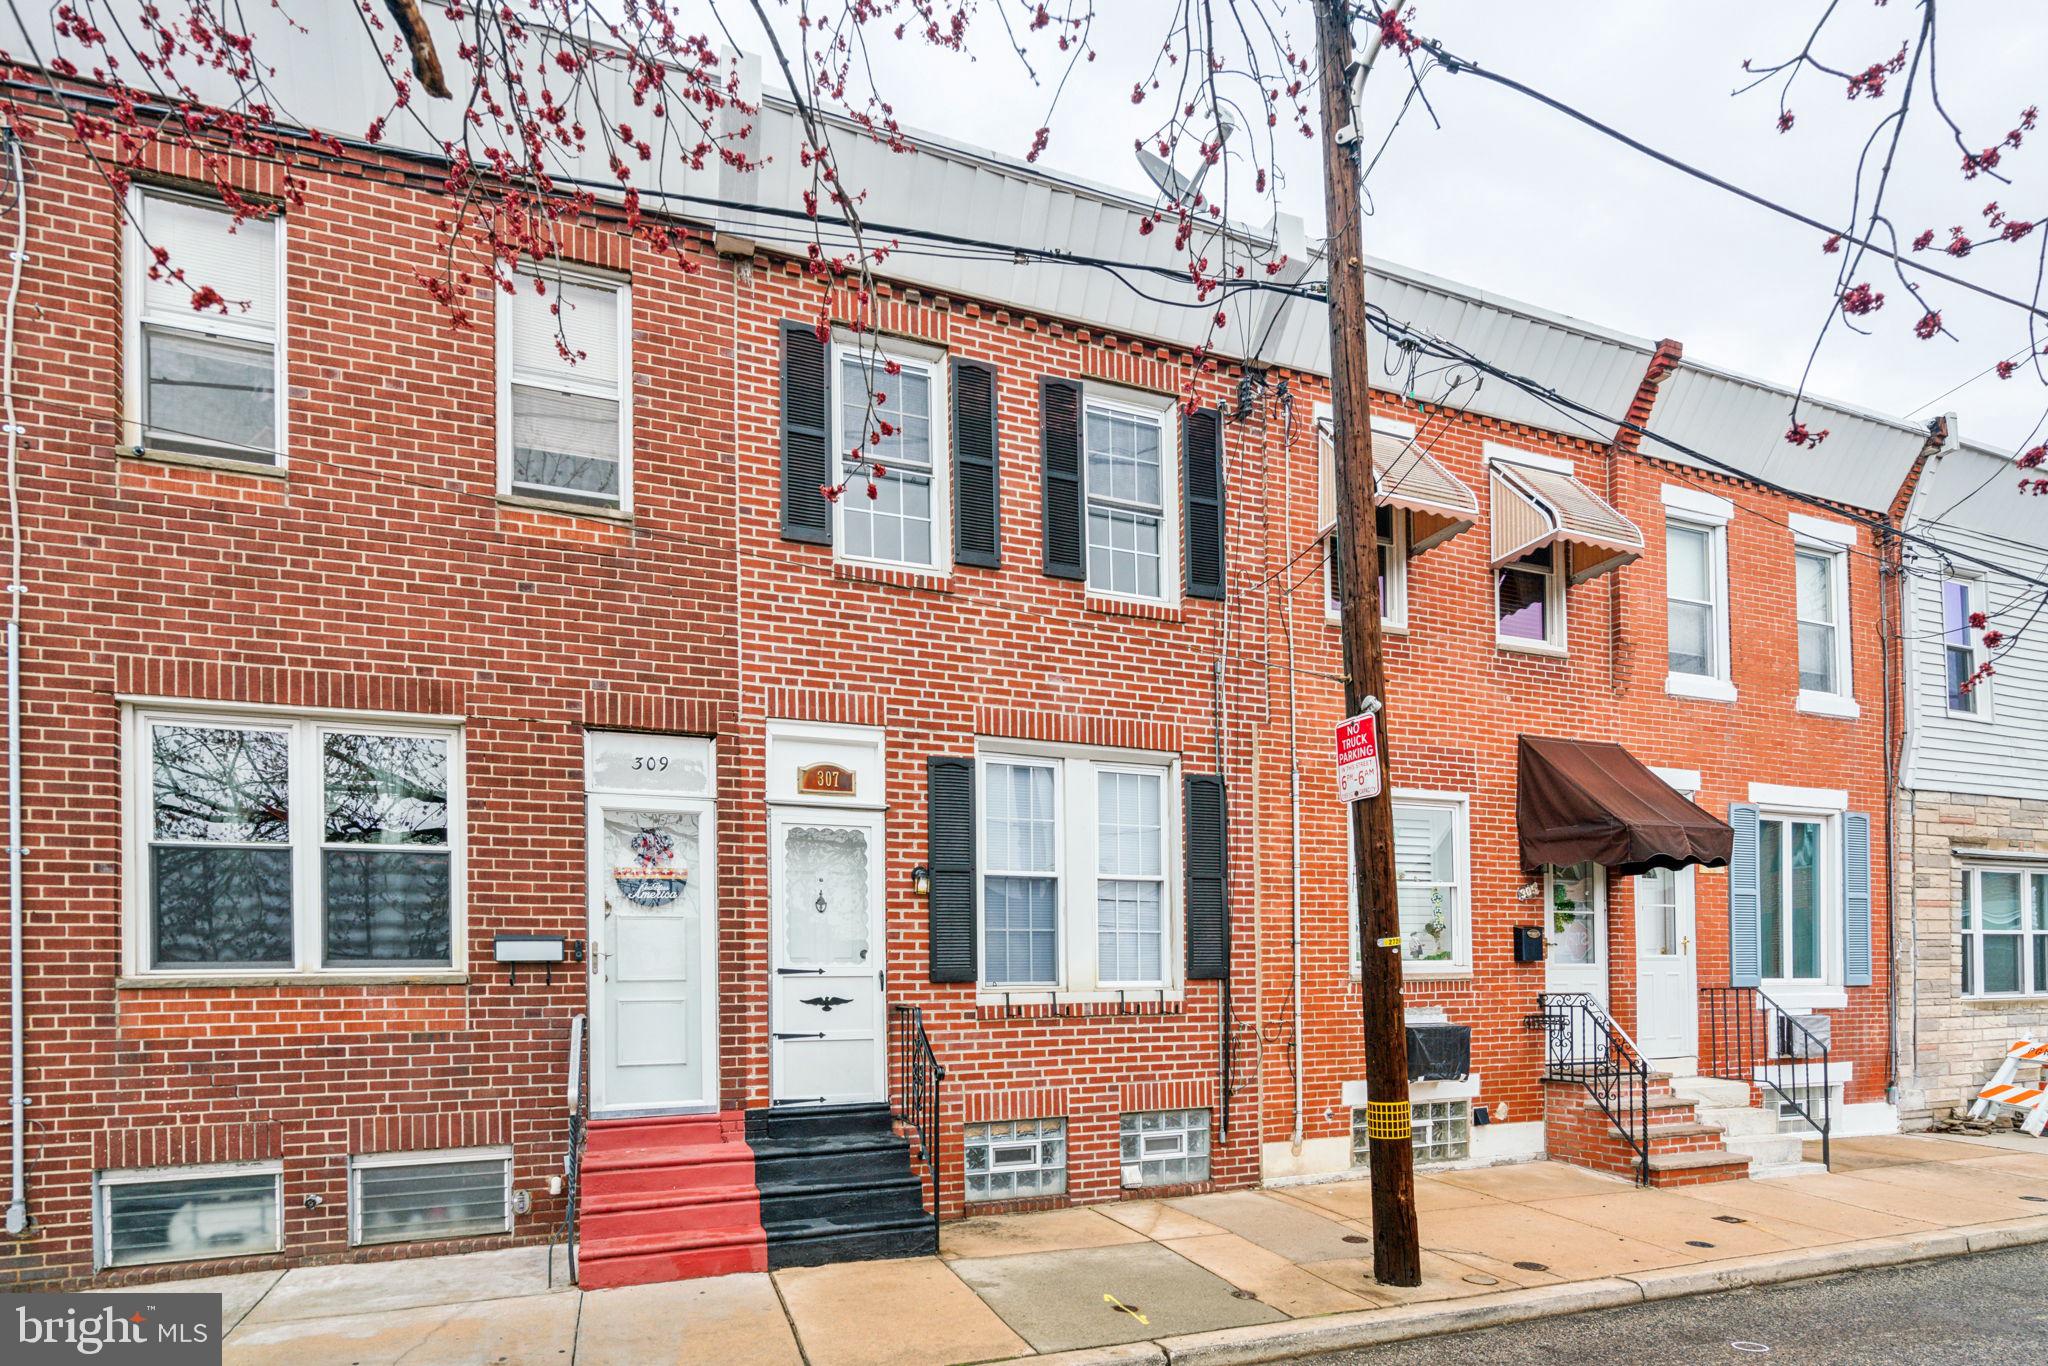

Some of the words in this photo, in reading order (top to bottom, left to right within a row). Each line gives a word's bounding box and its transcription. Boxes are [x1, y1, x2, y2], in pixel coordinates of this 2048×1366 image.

[1347, 723, 1359, 736] NO
[1342, 733, 1368, 750] TRUCK
[1339, 745, 1373, 763] PARKING
[631, 756, 669, 772] 309
[1355, 759, 1372, 768] STREET
[817, 770, 839, 787] 307
[628, 882, 678, 899] America
